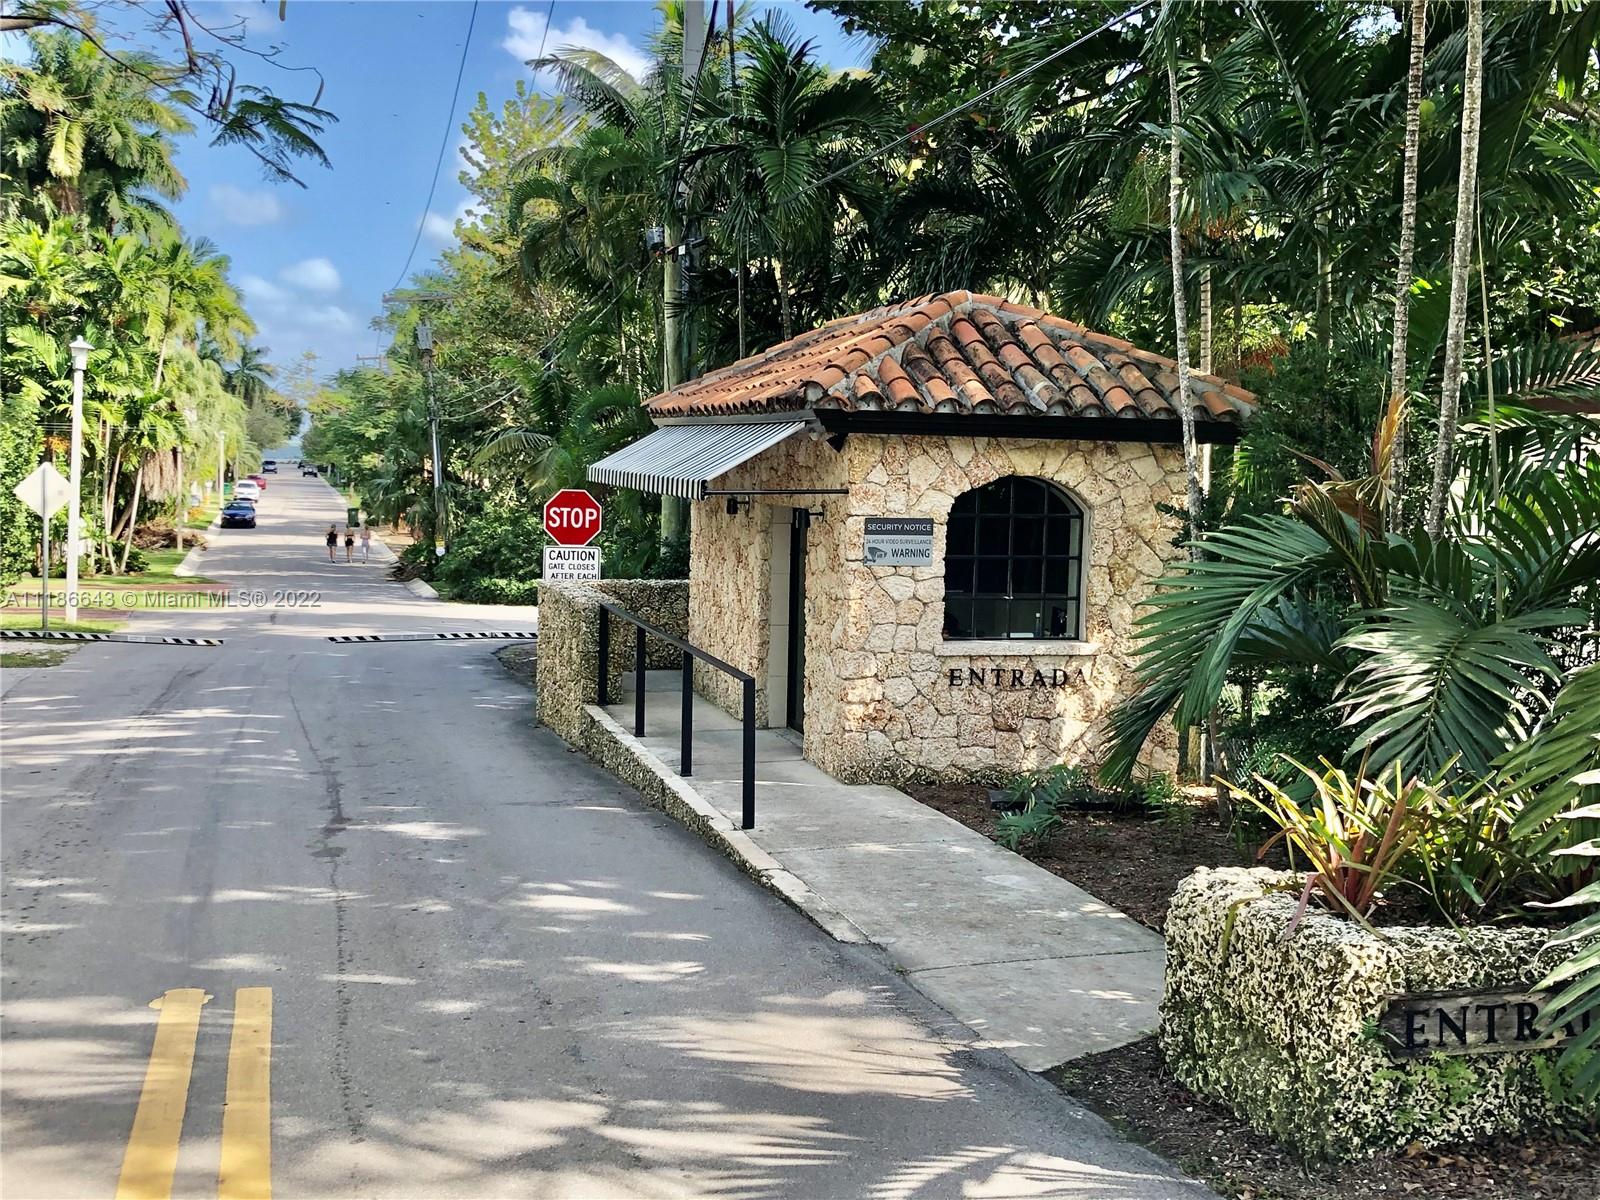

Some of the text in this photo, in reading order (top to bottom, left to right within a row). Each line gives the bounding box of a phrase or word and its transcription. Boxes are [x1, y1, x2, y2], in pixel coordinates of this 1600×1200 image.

[548, 507, 598, 529] STOP
[867, 523, 932, 531] SECURITY NOTICE
[548, 550, 596, 561] CAUTION
[891, 548, 930, 558] WARNING
[568, 563, 596, 571] CLOSES
[550, 572, 597, 580] AFTER EACH
[948, 667, 1088, 688] ENTRADA
[1404, 1002, 1591, 1050] ENTRA
